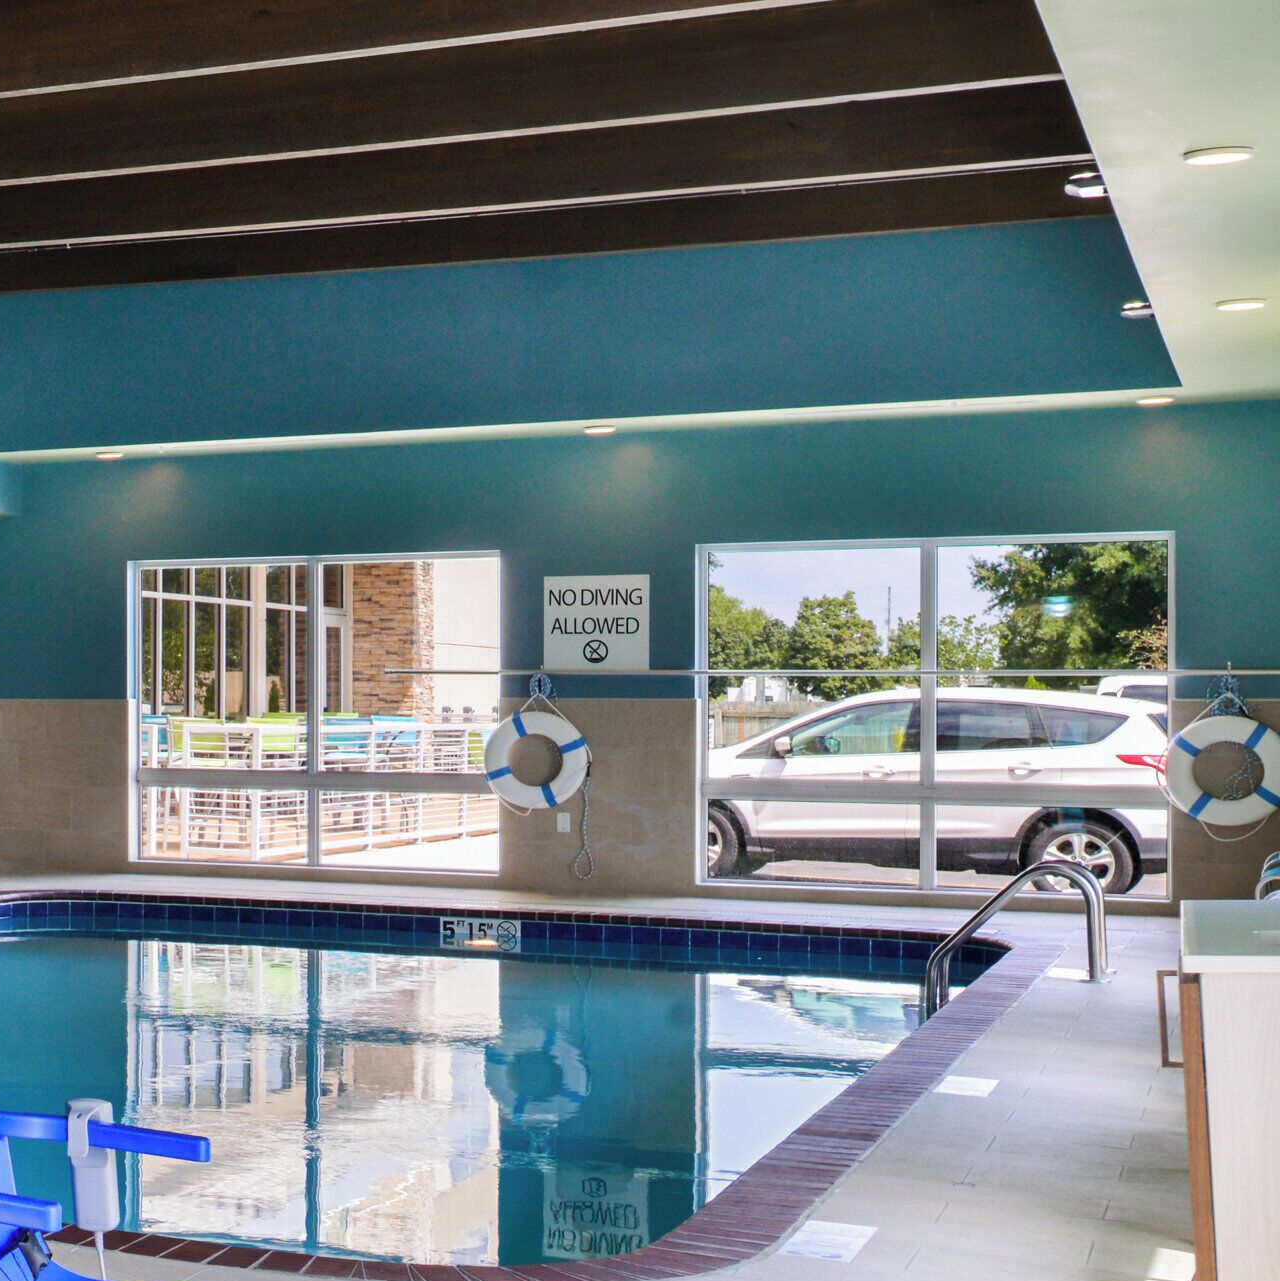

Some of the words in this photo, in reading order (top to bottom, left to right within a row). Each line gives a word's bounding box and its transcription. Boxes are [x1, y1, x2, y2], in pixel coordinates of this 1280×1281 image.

[549, 589, 577, 606] NO
[581, 588, 643, 606] DIVING
[551, 617, 640, 635] ALLOWED
